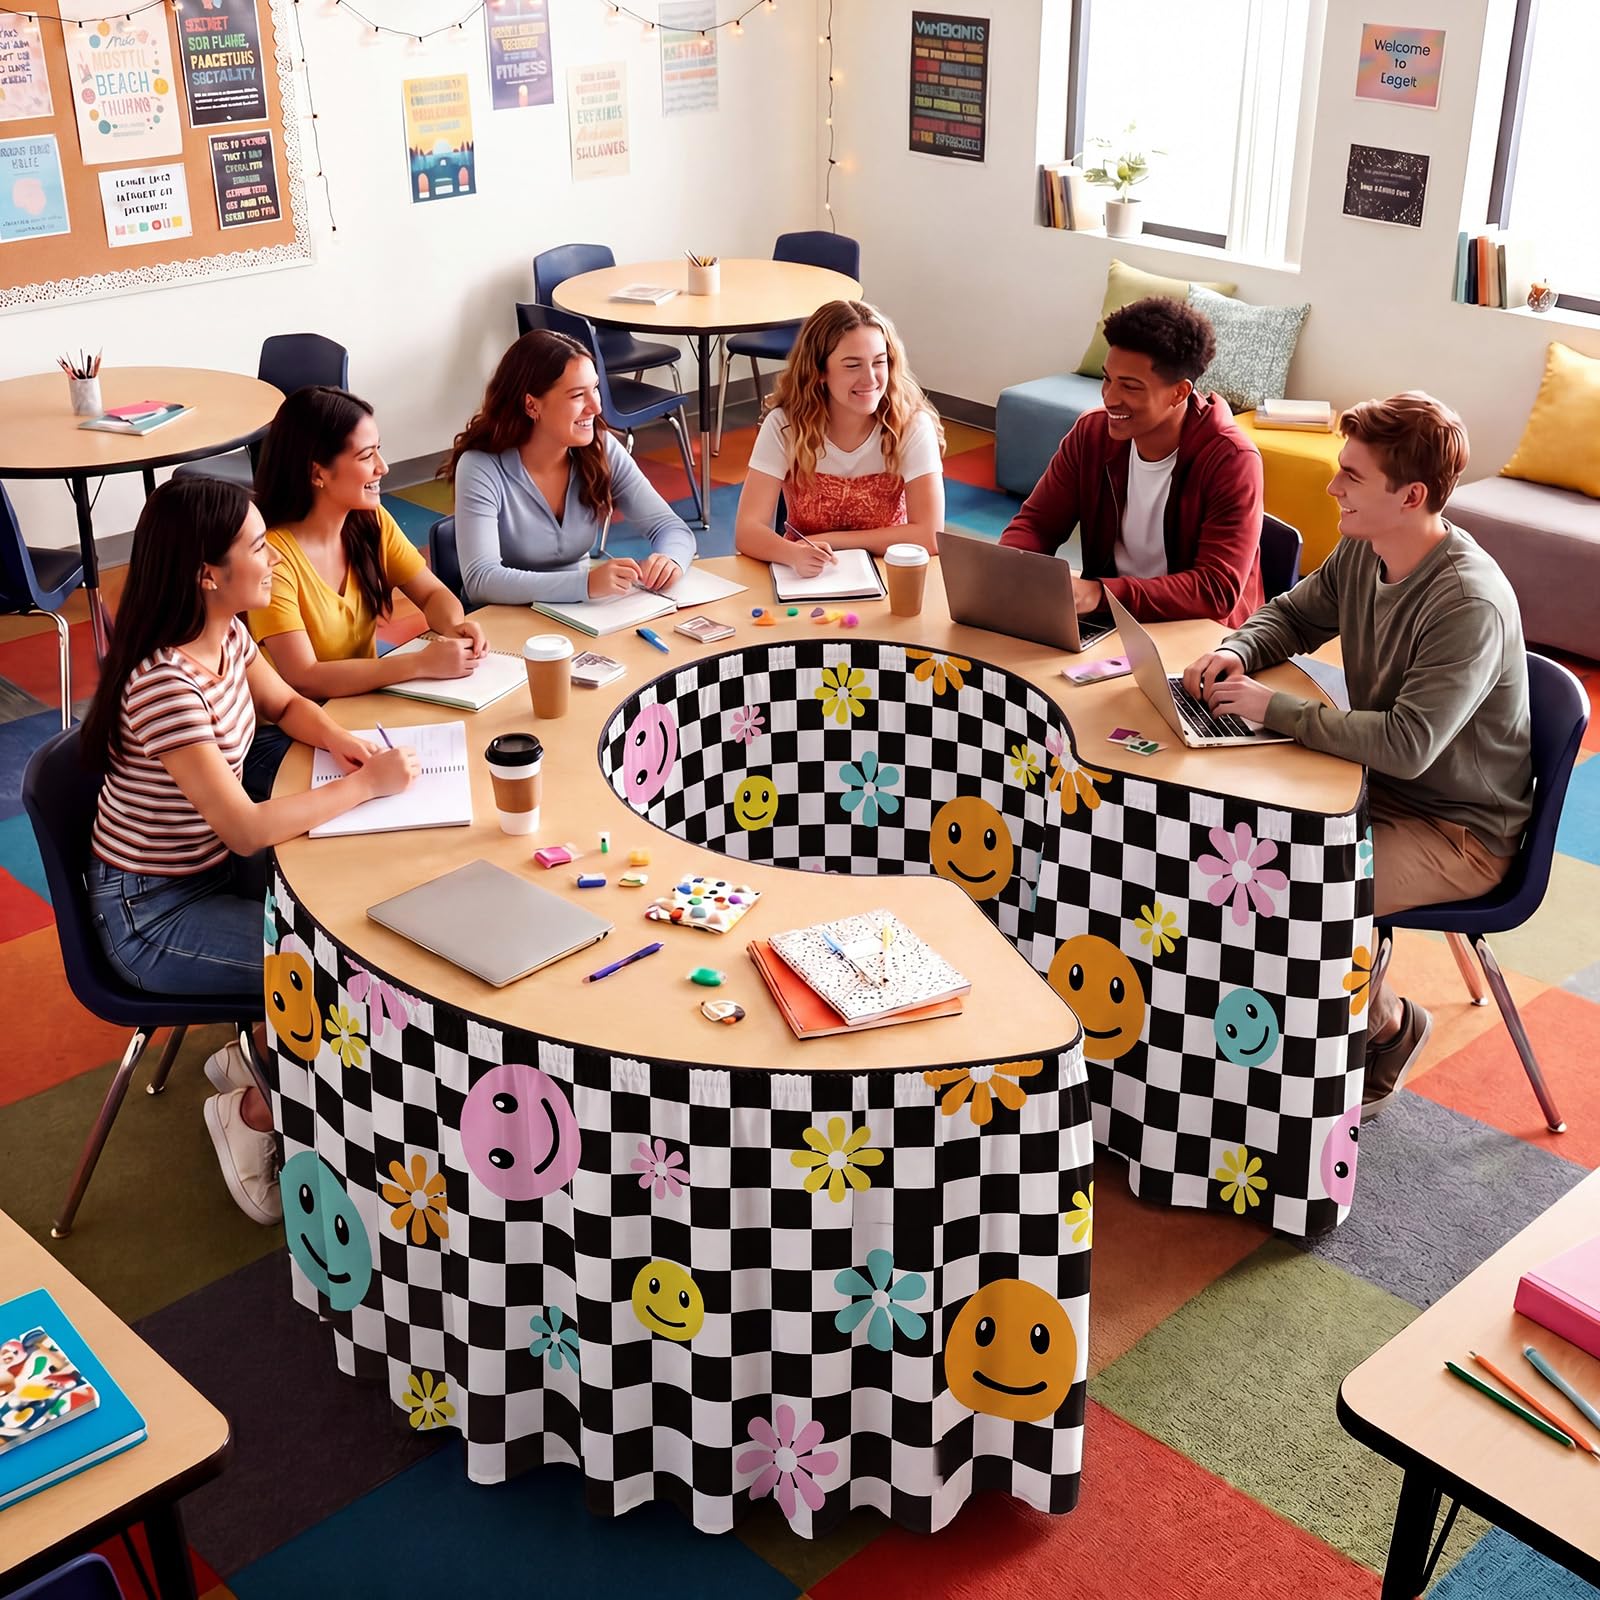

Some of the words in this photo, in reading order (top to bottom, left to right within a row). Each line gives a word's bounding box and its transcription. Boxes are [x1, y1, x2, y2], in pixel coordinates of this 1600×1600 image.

[1375, 39, 1430, 56] Welcome
[1395, 58, 1406, 69] to
[96, 72, 150, 96] BEACH
